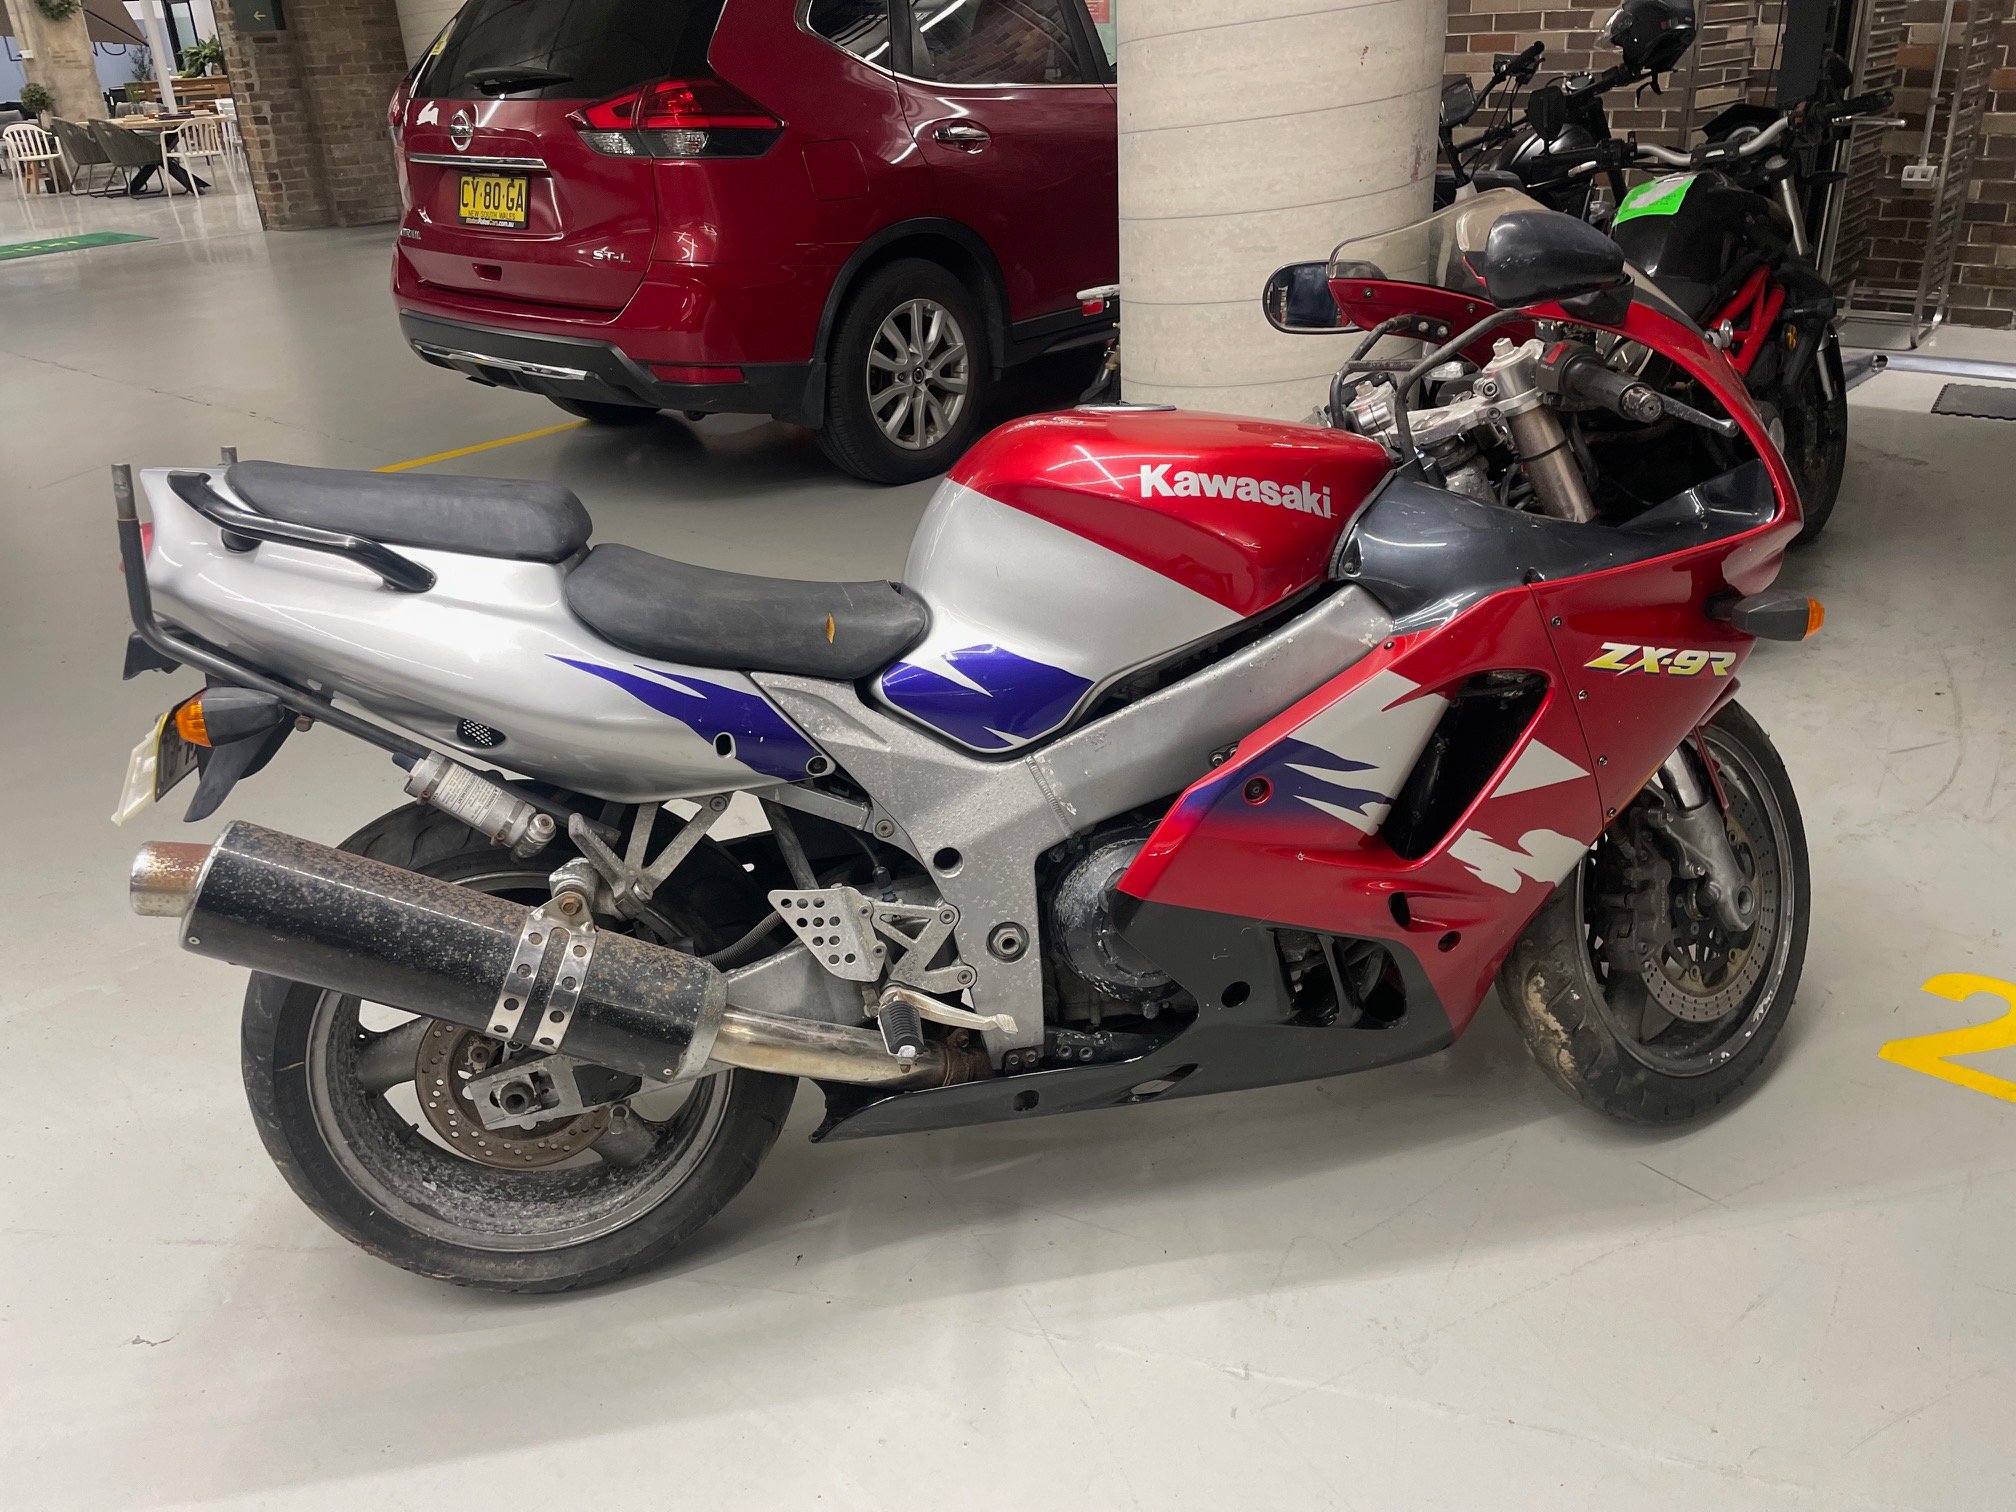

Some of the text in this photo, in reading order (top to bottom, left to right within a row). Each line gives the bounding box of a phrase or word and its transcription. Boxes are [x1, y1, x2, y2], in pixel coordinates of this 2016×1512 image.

[480, 211, 498, 219] SOUTH
[499, 212, 516, 220] WALES
[593, 250, 631, 263] ST-L
[1140, 463, 1332, 519] Kawasaki
[1584, 641, 1737, 676] ZX-9R
[1877, 972, 2016, 1103] 2
